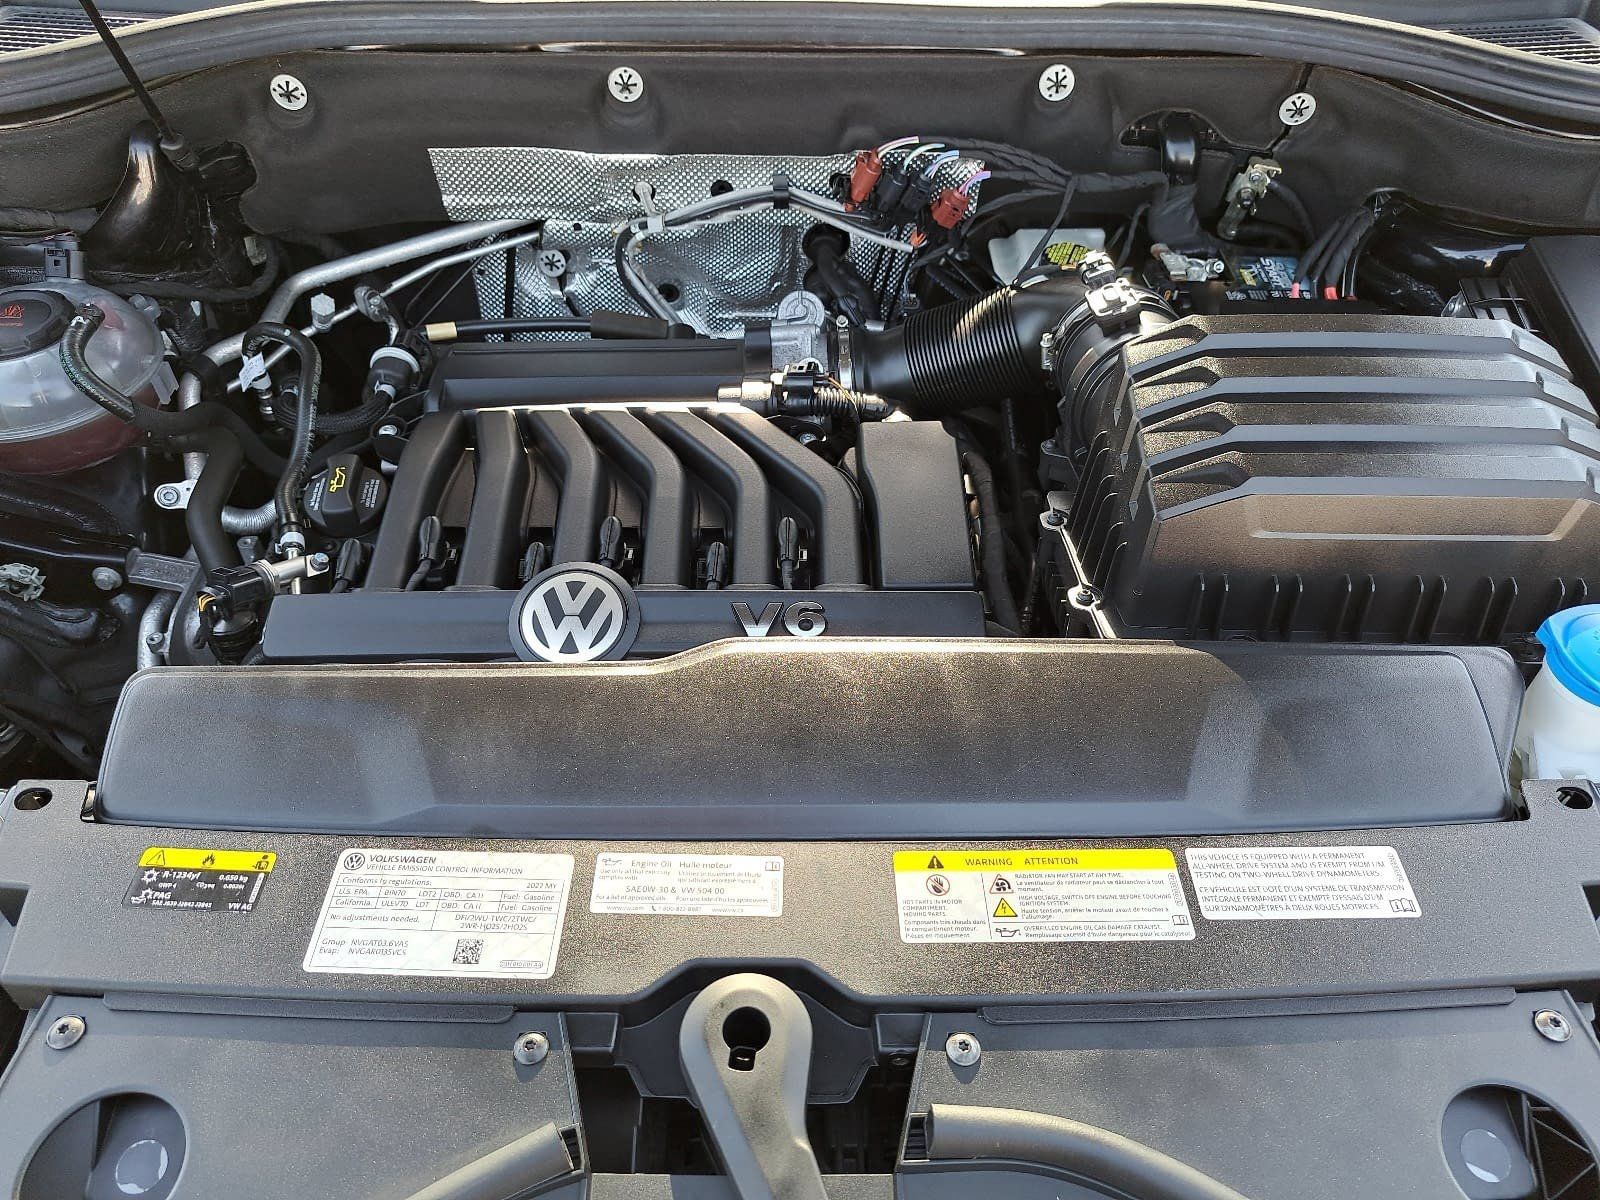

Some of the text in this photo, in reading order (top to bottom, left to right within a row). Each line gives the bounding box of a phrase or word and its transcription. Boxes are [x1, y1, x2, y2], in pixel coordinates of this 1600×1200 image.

[731, 600, 827, 637] V6
[369, 854, 437, 864] VOLKSWAGEN
[965, 857, 1078, 866] WARNING ATTENTION
